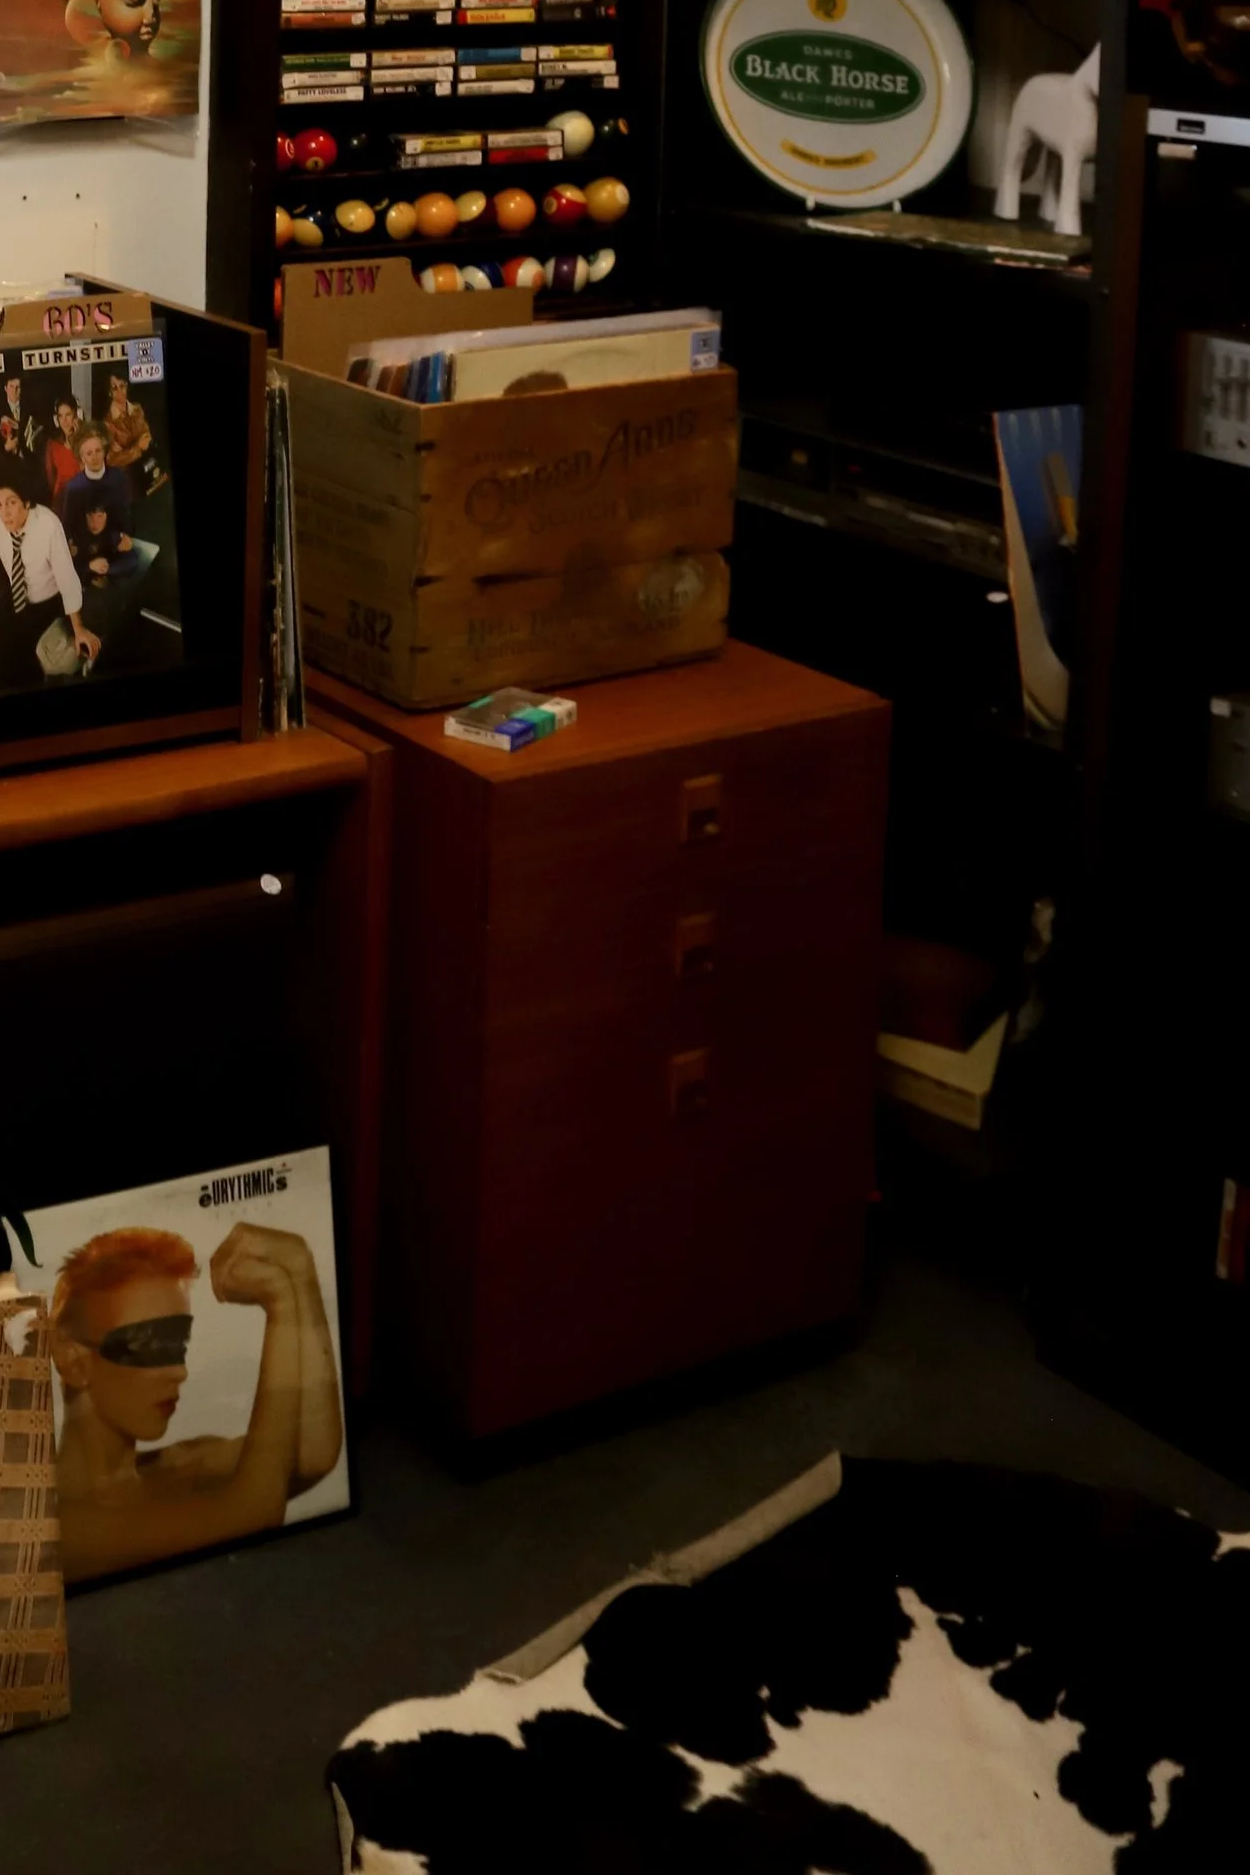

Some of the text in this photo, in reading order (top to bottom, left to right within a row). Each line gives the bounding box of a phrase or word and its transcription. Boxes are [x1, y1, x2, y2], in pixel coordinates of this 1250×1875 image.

[745, 53, 910, 95] BLACK HORSE
[313, 265, 382, 298] NEW
[347, 598, 394, 653] 382
